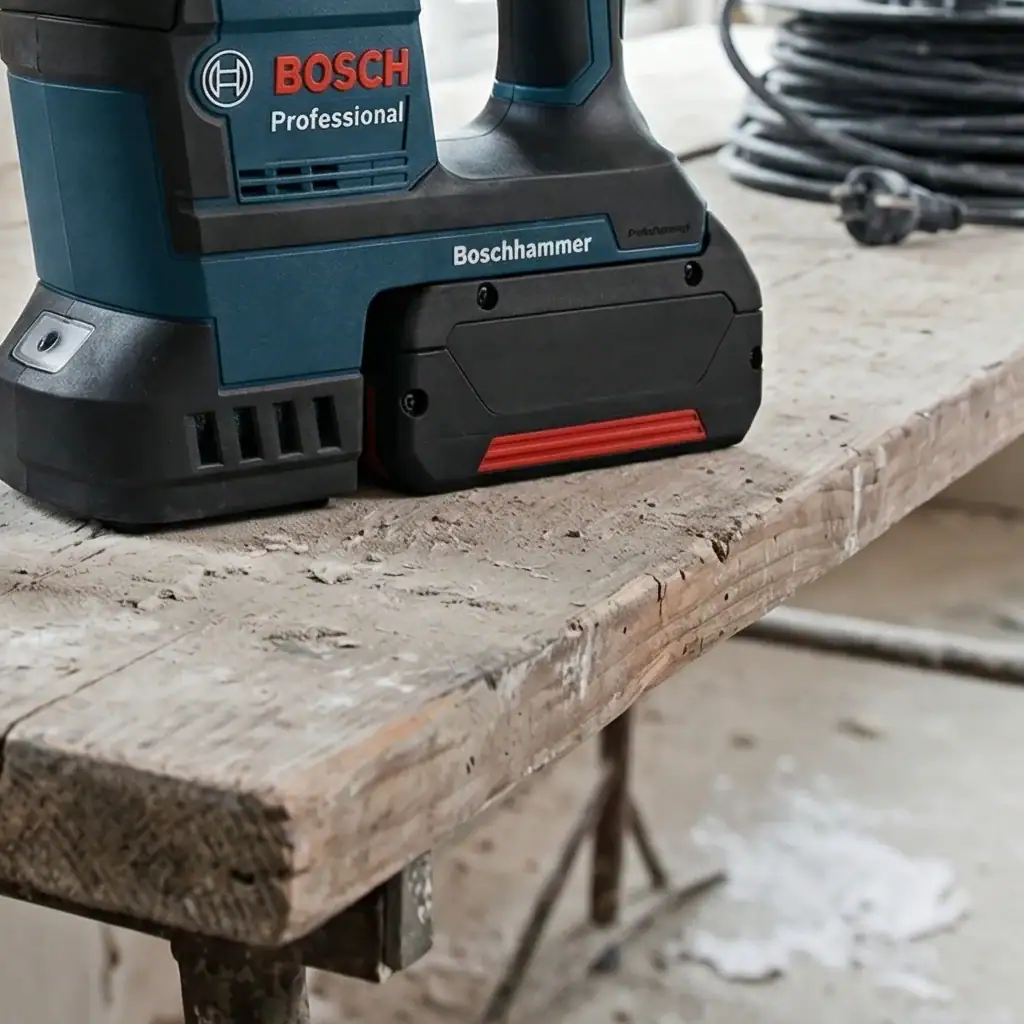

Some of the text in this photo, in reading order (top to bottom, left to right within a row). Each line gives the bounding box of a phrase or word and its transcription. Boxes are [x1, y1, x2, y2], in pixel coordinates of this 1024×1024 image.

[274, 47, 409, 95] BOSCH
[271, 101, 404, 133] Professional
[453, 236, 593, 267] Boschhammer
